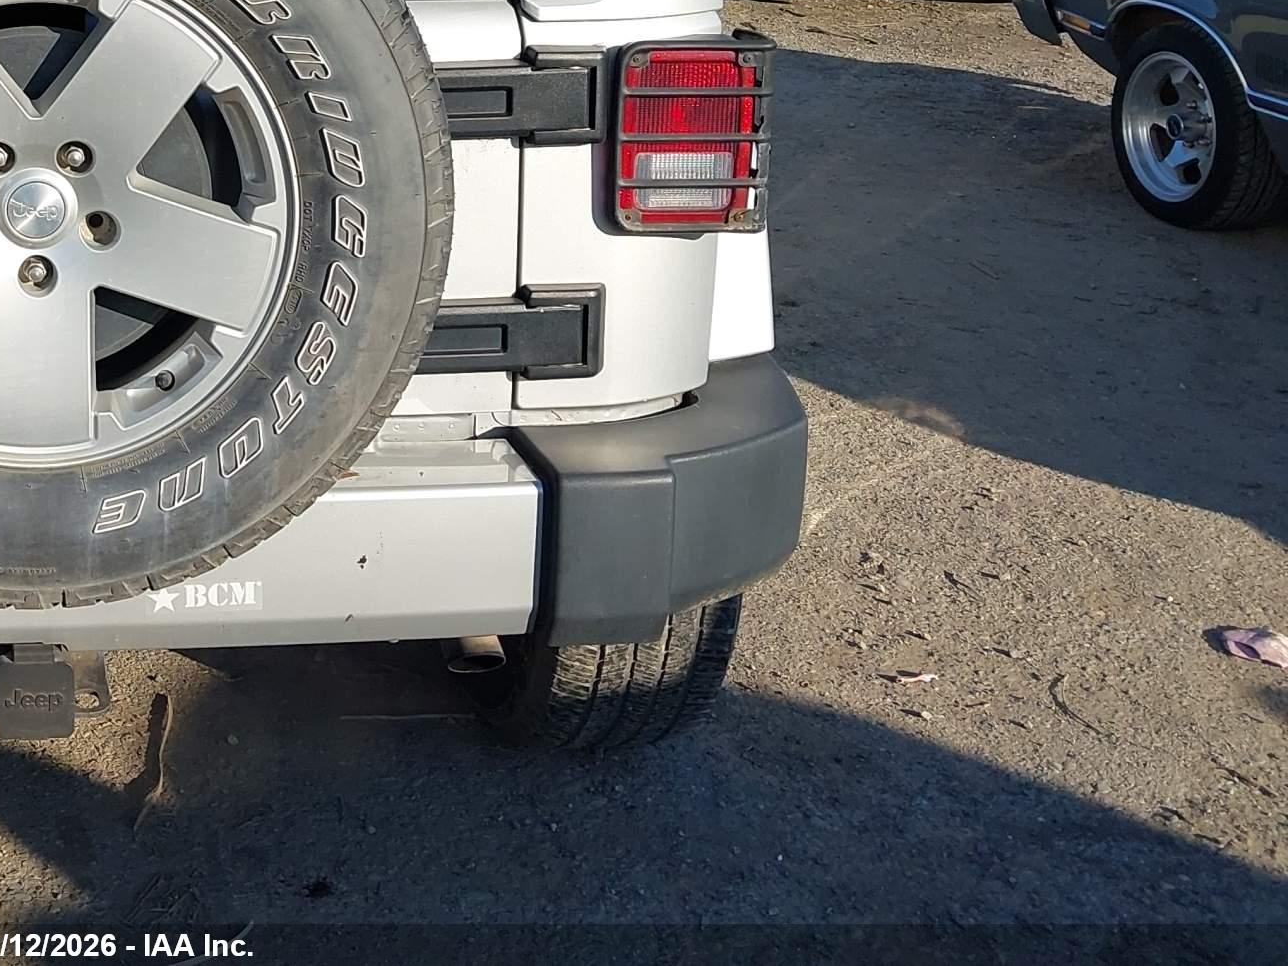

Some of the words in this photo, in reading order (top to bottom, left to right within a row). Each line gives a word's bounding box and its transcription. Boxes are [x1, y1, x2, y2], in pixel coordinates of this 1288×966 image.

[12, 202, 59, 221] Jeep
[184, 581, 257, 608] BCM
[5, 689, 64, 712] Jeep
